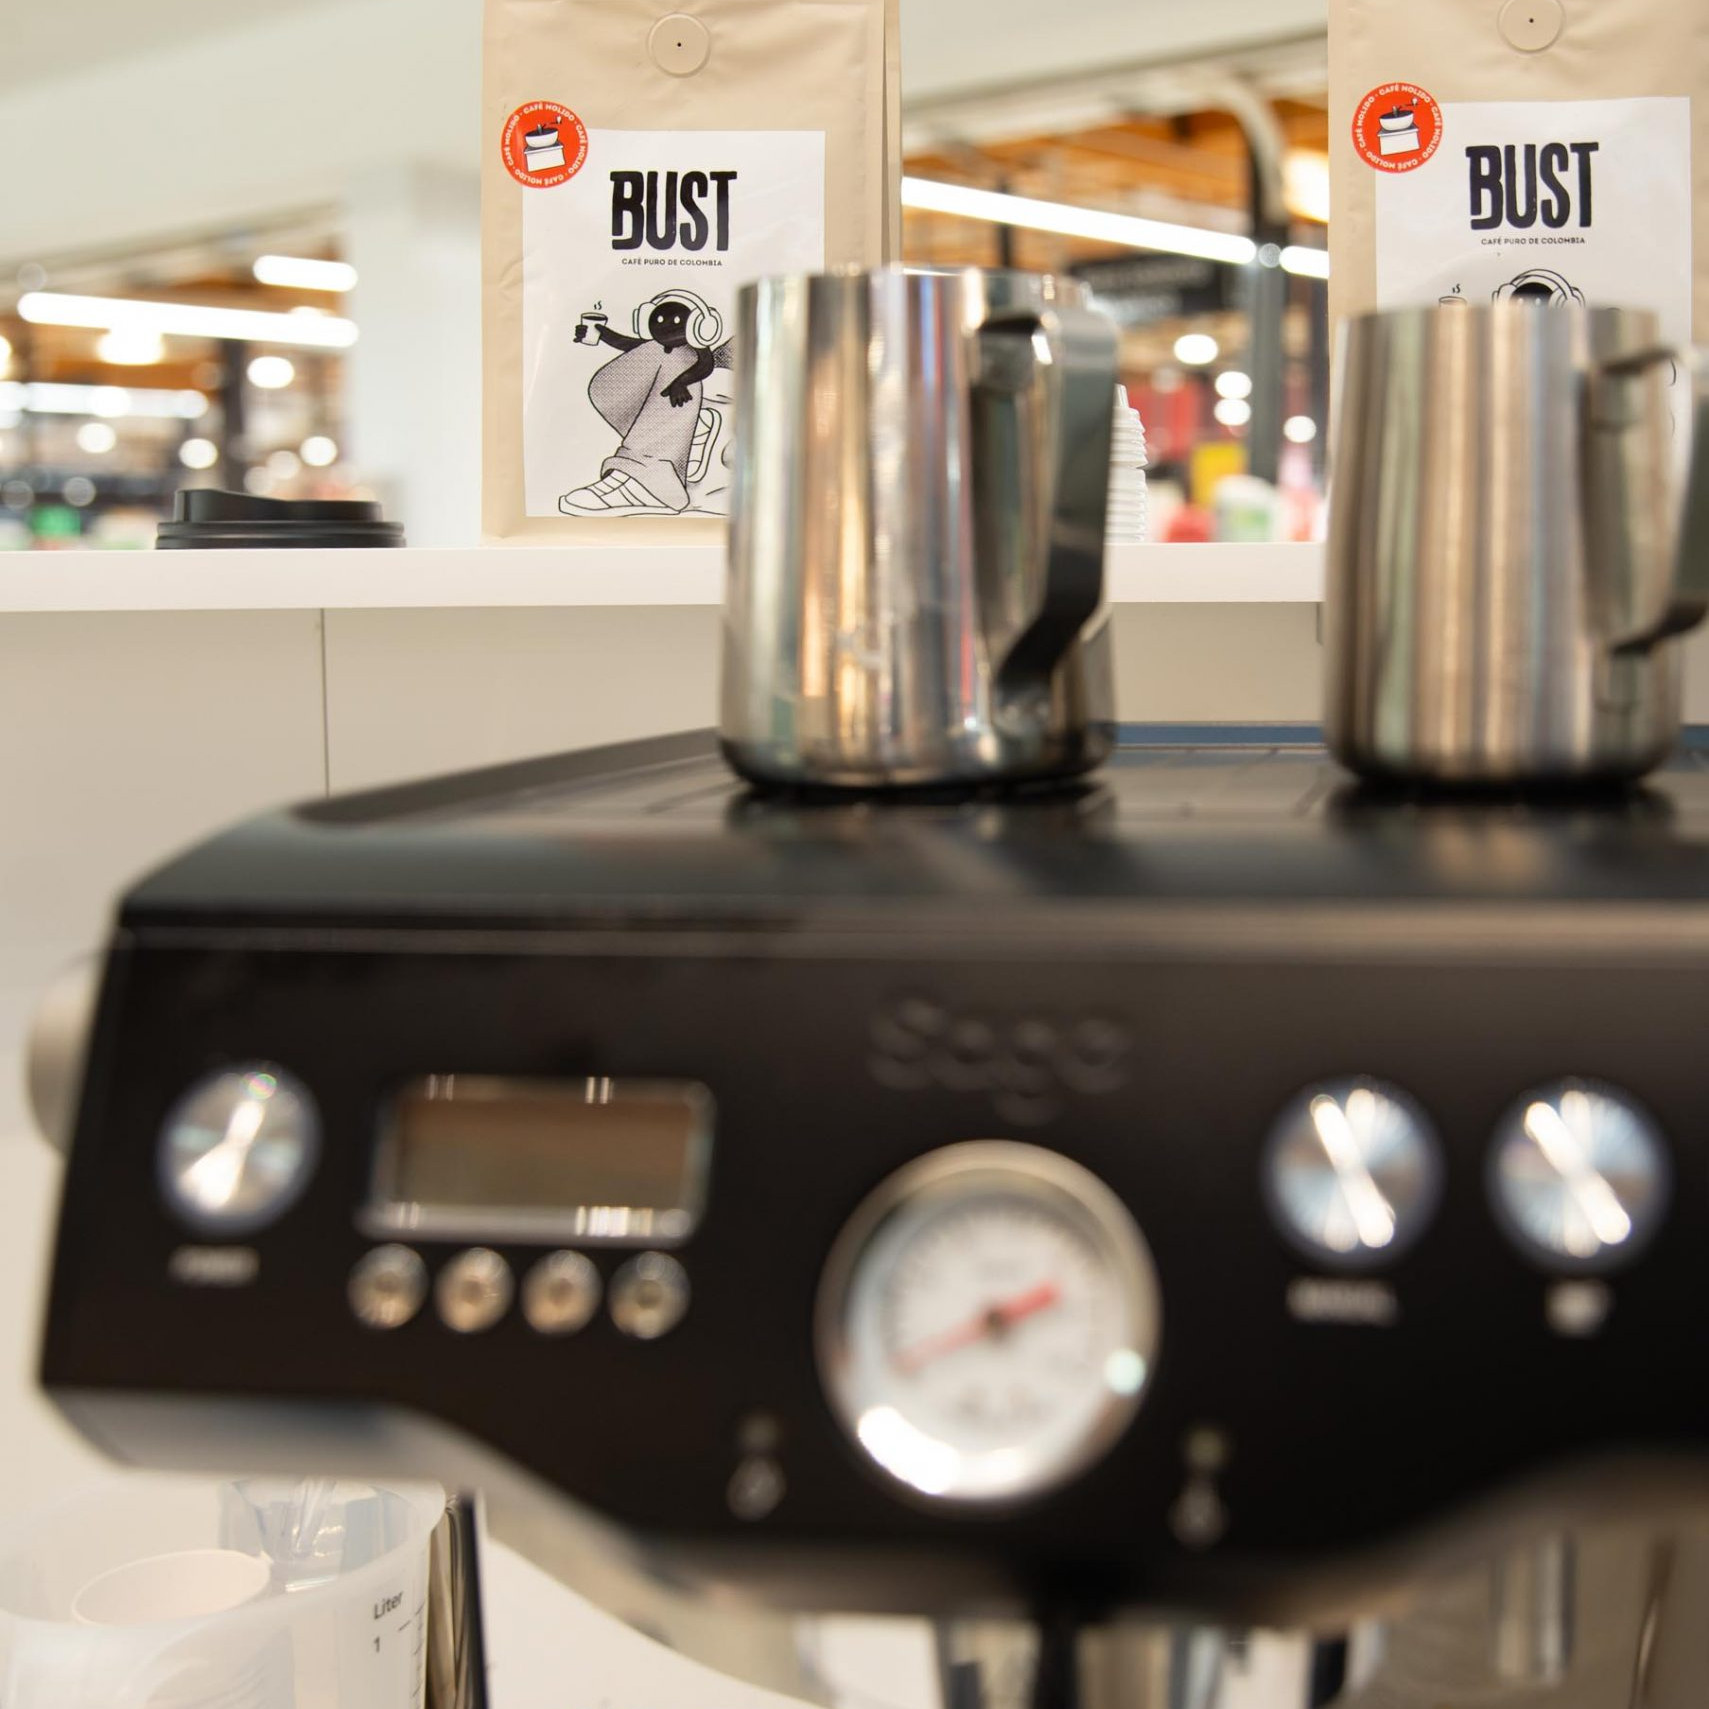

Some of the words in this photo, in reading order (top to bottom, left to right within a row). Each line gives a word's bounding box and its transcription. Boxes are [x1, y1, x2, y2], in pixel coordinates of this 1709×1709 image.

[1465, 142, 1600, 230] BUST
[610, 170, 738, 252] BUST
[1481, 237, 1501, 245] CAFÉ
[374, 1590, 404, 1620] Liter
[374, 1636, 380, 1653] 1
